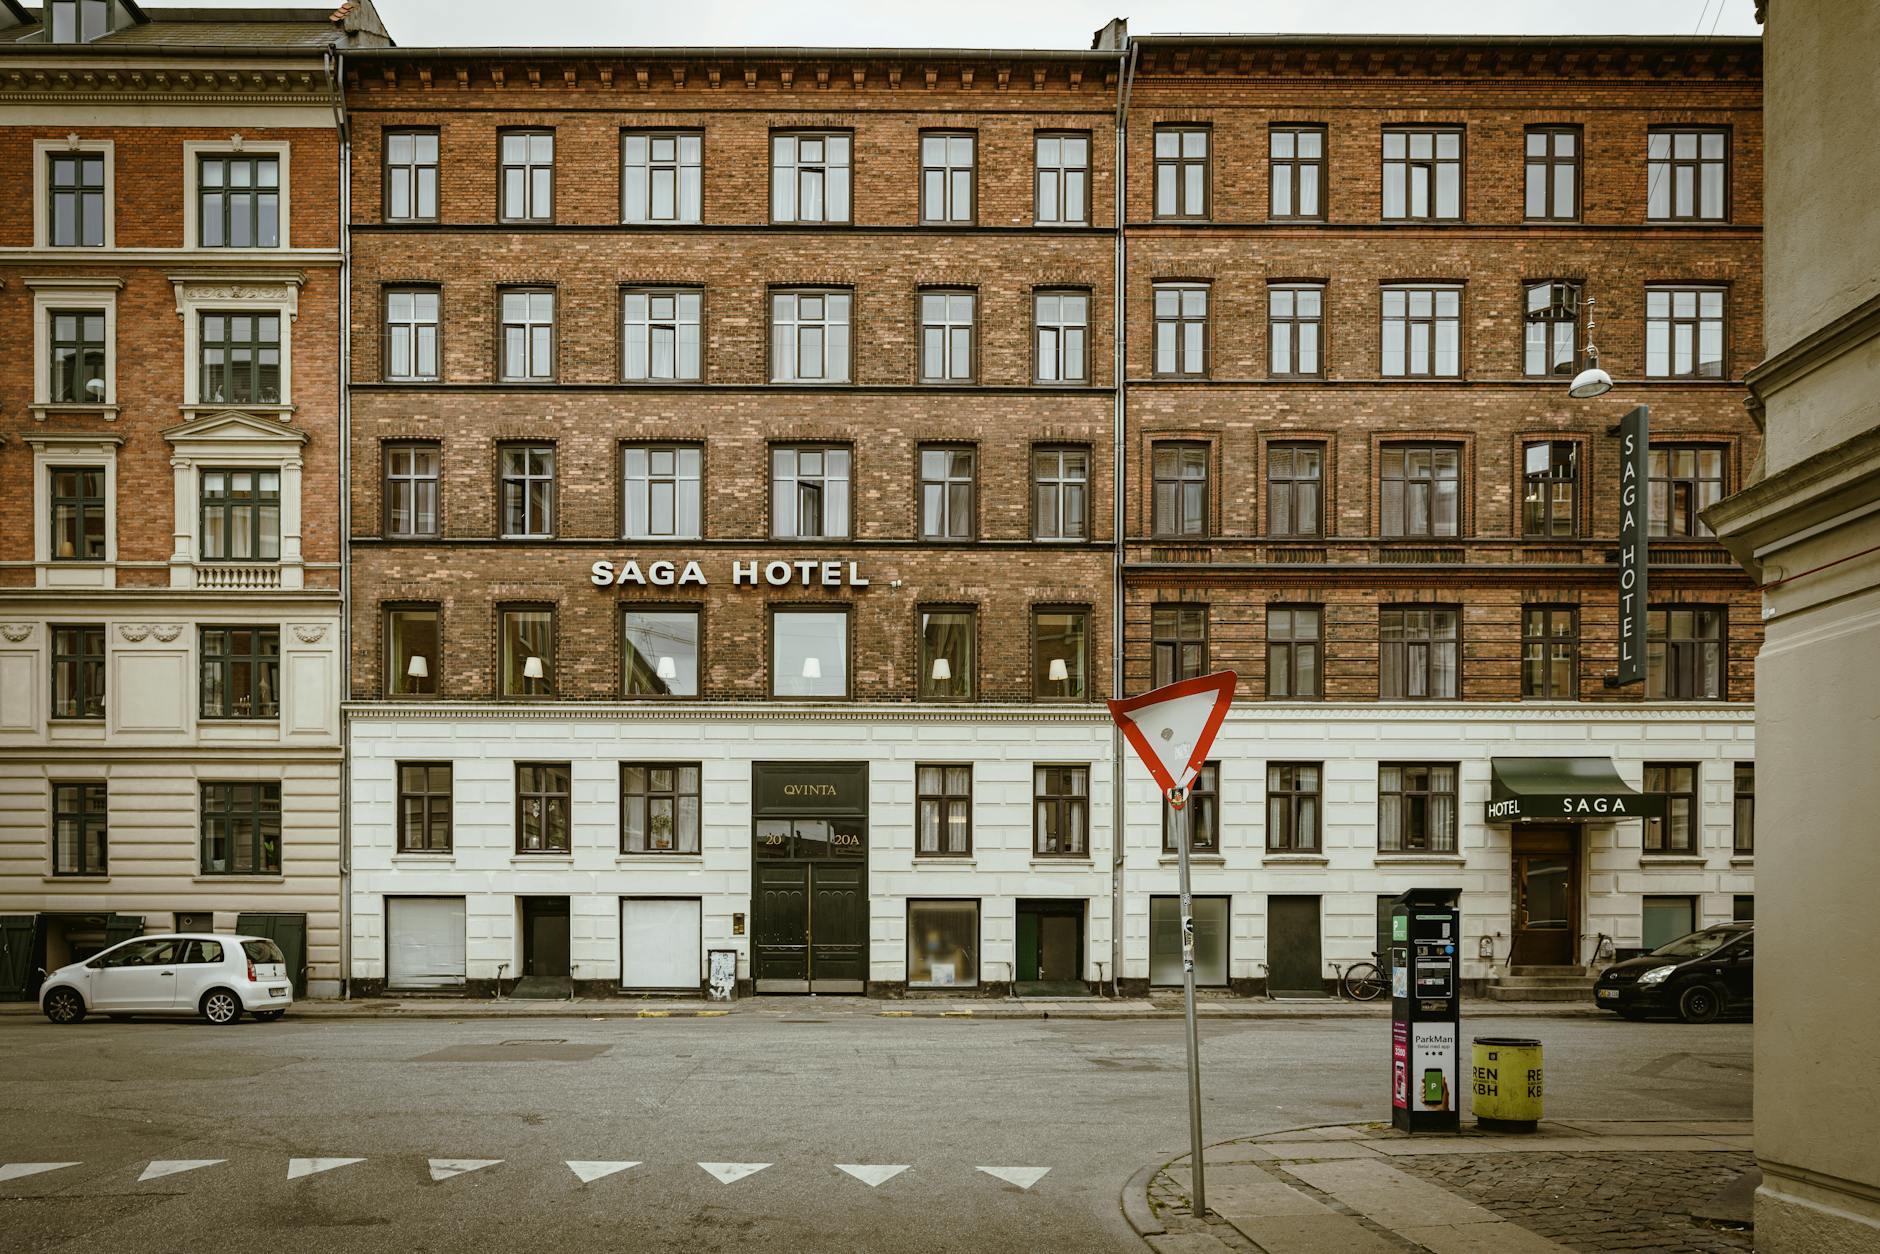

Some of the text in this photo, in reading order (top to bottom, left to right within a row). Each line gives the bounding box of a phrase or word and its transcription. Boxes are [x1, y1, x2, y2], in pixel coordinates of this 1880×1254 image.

[1621, 433, 1636, 661] SAGA HOTEL
[591, 560, 869, 586] SAGA HOTEL
[784, 784, 837, 795] QVINTA
[1488, 799, 1521, 818] HOTEL
[1563, 798, 1626, 813] SAGA
[766, 834, 782, 845] 20
[834, 834, 860, 845] 20A
[1415, 1035, 1453, 1043] ParkMan
[1472, 1066, 1498, 1080] REN
[1528, 1069, 1542, 1081] RE
[1472, 1083, 1498, 1096] KBH
[1528, 1085, 1542, 1098] KB
